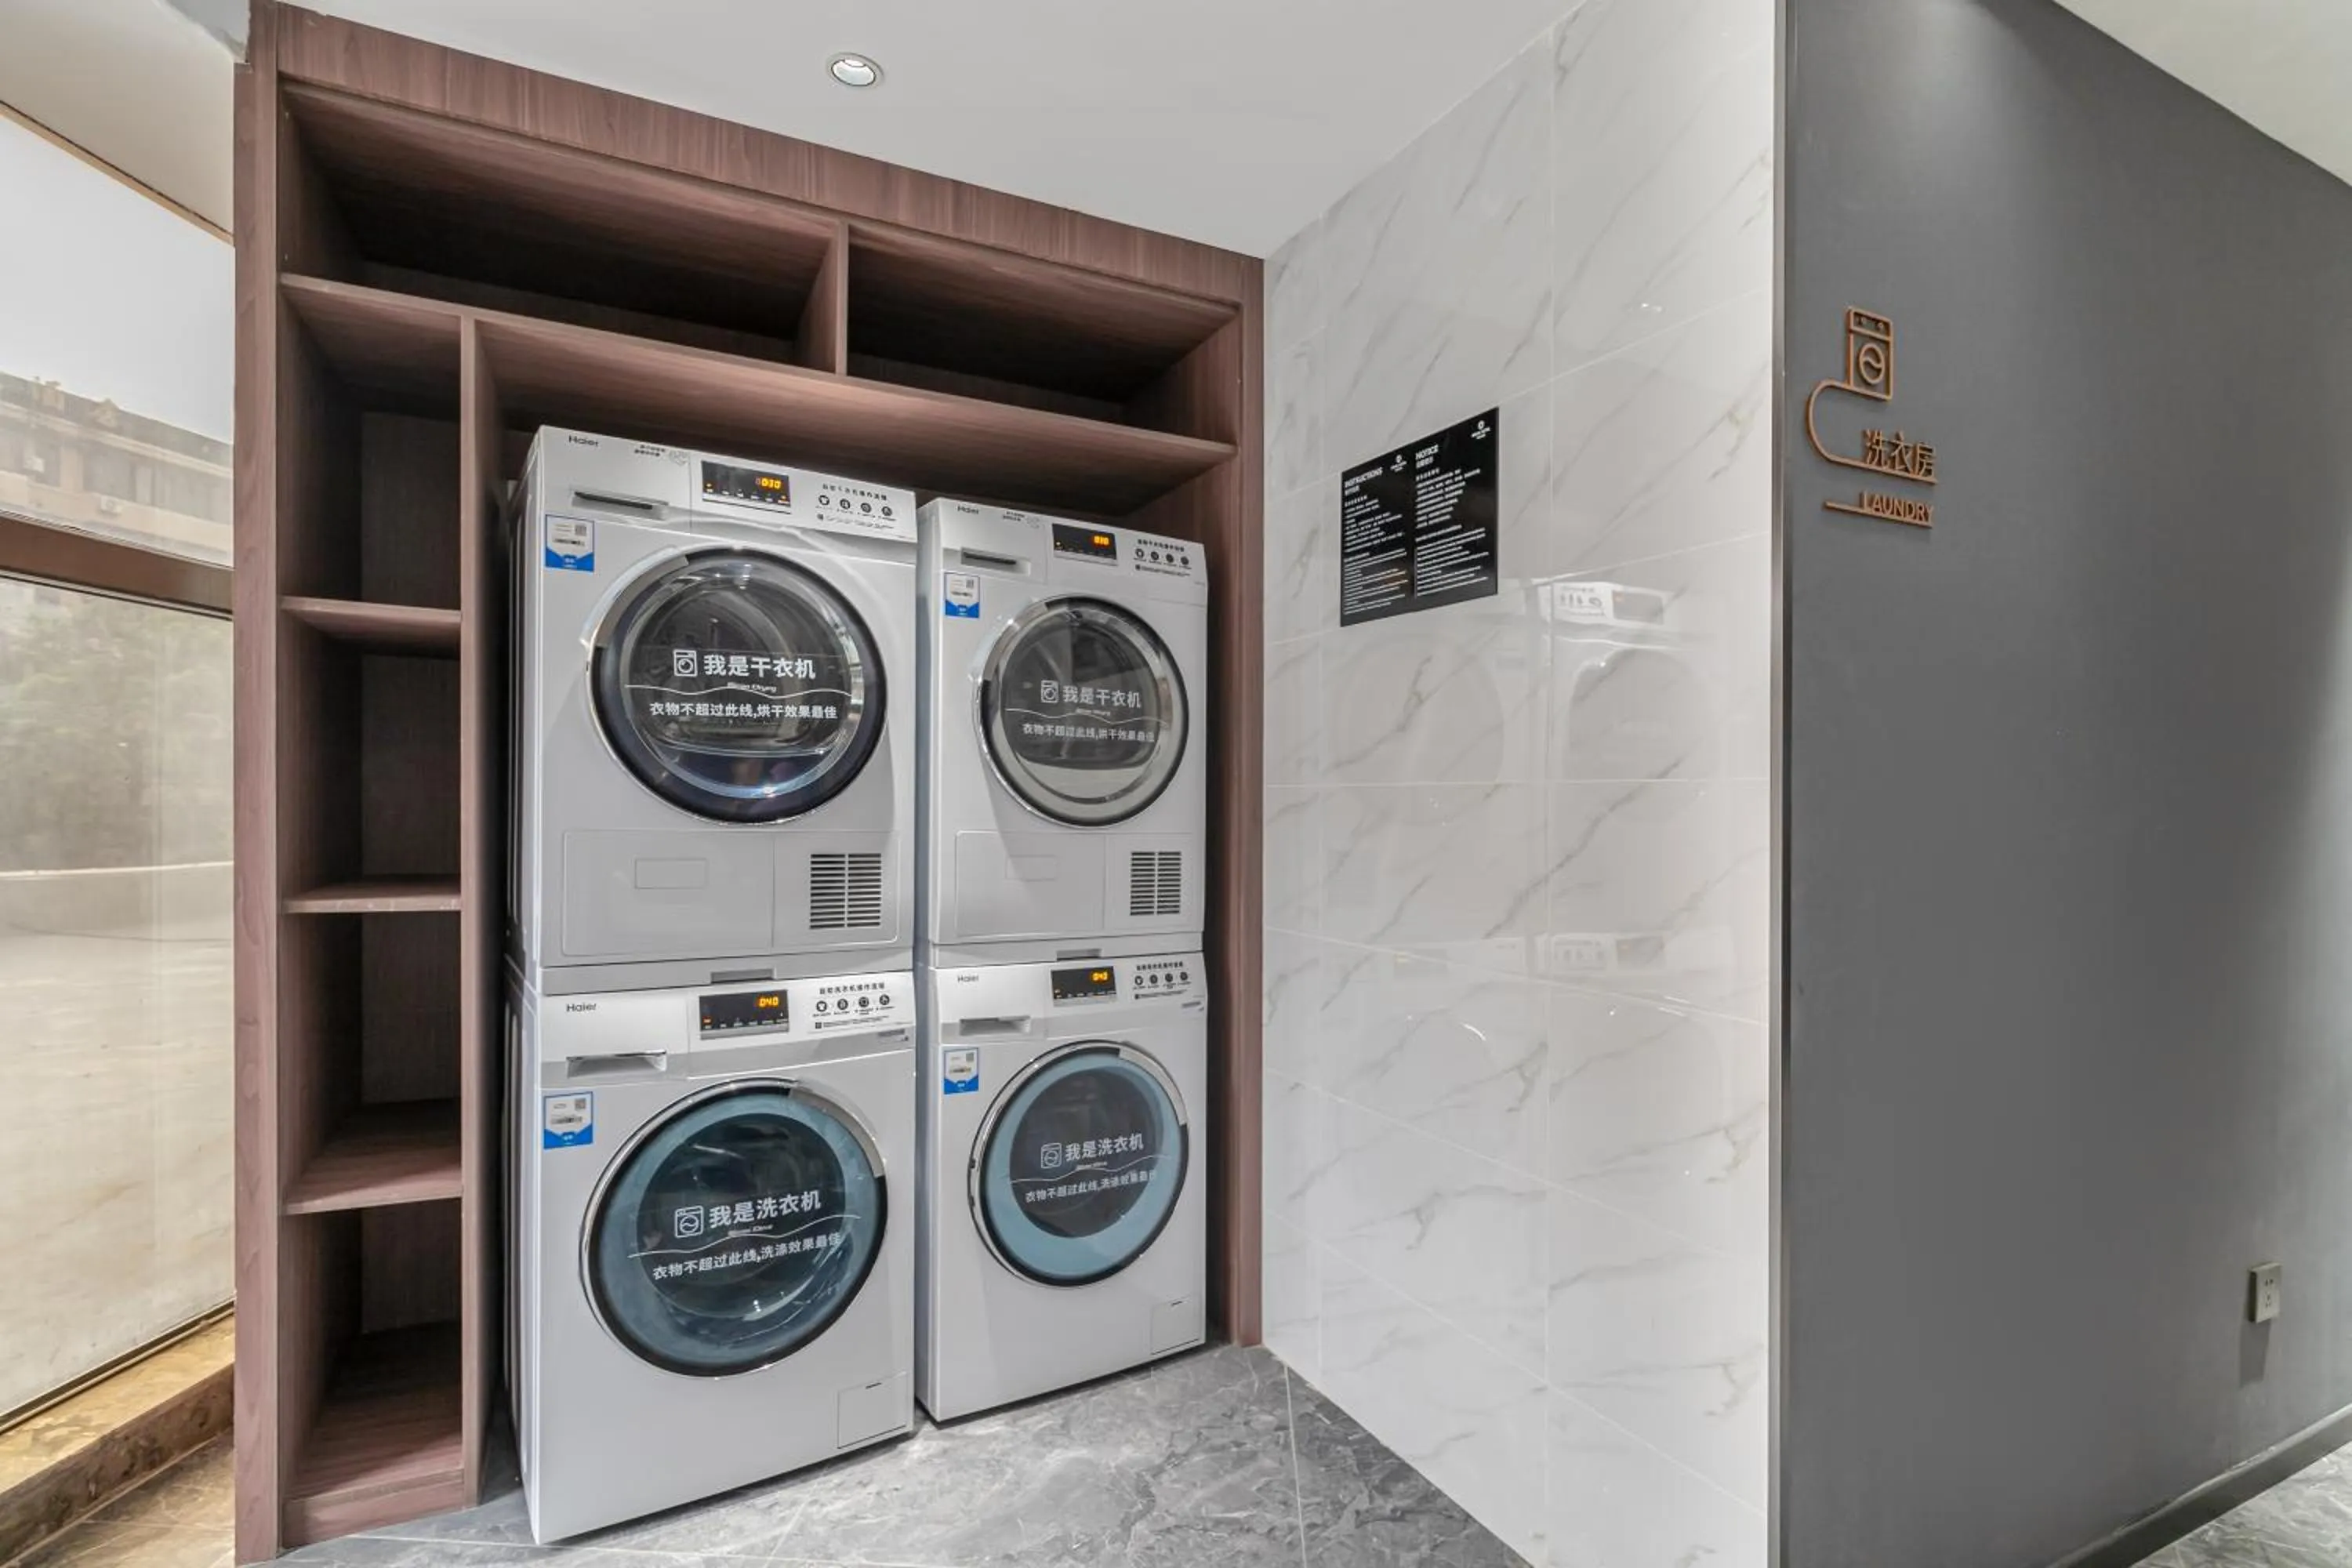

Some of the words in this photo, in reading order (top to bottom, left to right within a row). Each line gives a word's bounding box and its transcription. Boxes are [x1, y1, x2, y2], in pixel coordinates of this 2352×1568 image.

[1862, 428, 1936, 477] 洗衣房
[1859, 490, 1934, 524] LAUNDRY
[703, 654, 816, 680] 我是干衣机
[1062, 684, 1142, 709] 我是干衣机
[566, 1002, 597, 1012] Haier
[1065, 1132, 1145, 1162] 我是洗衣机
[709, 1189, 822, 1229] 我是洗衣机
